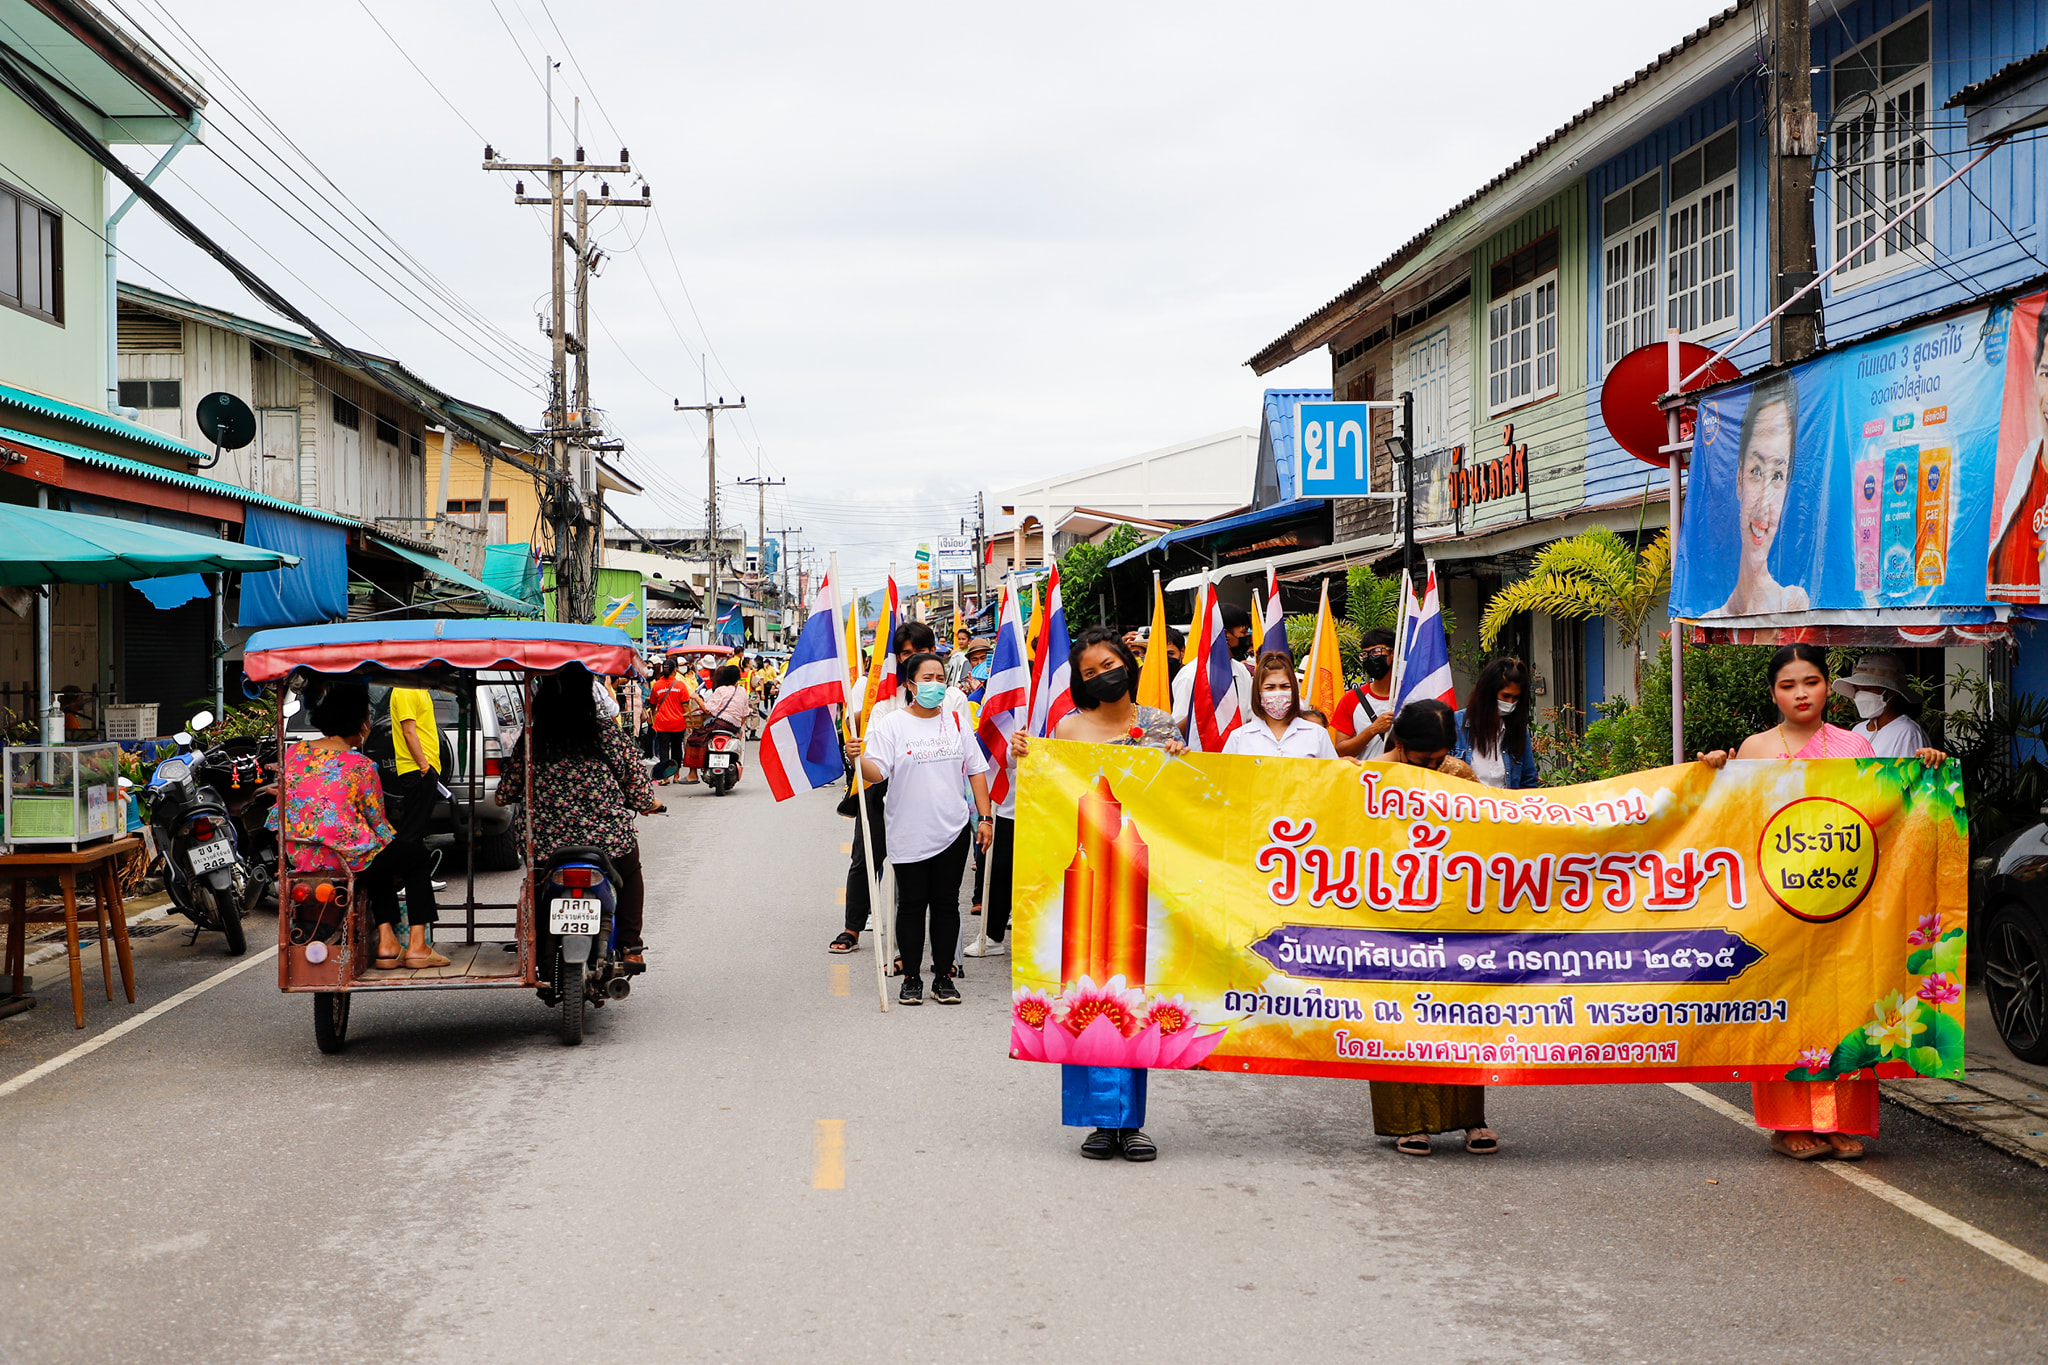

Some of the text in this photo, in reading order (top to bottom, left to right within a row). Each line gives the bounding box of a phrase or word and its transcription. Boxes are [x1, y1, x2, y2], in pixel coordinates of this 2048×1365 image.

[1857, 353, 1896, 379] กันแดด
[1901, 345, 1909, 368] 3
[1913, 323, 1964, 371] สูตรที่ใช่
[1871, 375, 1940, 406] อวดผิวใสสู้แดด
[1304, 420, 1363, 480] ยา
[1448, 424, 1527, 509] บ้านเภสัช
[1860, 516, 1876, 527] AURA
[1863, 529, 1871, 539] 50
[1361, 772, 1648, 825] โครงการจัดงาน
[1775, 823, 1861, 854] ประจำปี
[203, 857, 226, 871] 242
[1257, 818, 1746, 912] วันเข้าพรรษา
[1781, 866, 1859, 889] ๒๕๖๕
[562, 900, 591, 910] กลก
[560, 922, 589, 933] 439
[1278, 936, 1735, 977] วันพฤหัสบดีที่ ๑๔ กรกฎาคม ๒๕๖๕
[1223, 988, 1787, 1026] ถวายเทียน ณ วัดคลองวาฬ พระอารามหลวง
